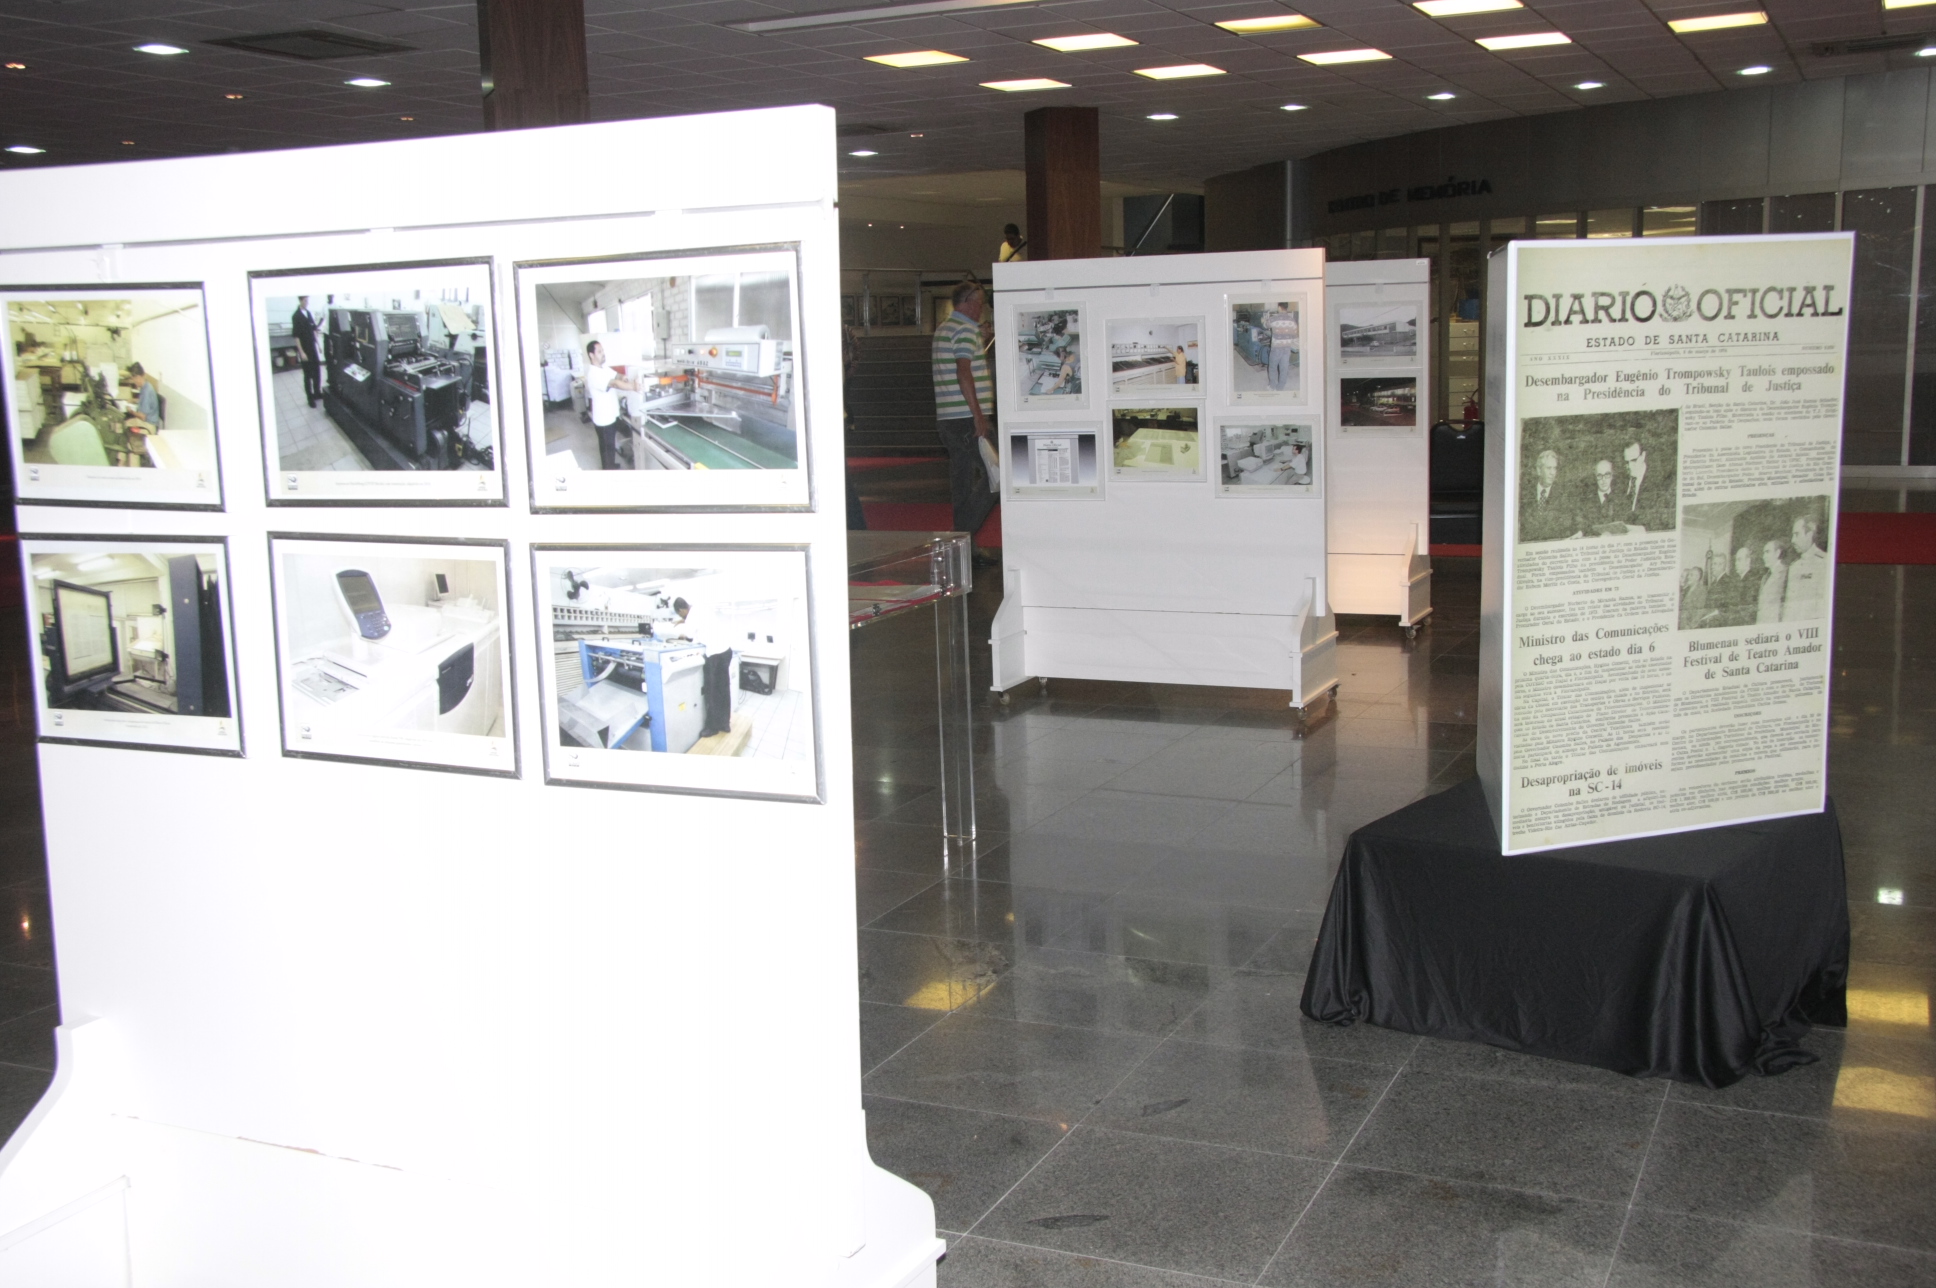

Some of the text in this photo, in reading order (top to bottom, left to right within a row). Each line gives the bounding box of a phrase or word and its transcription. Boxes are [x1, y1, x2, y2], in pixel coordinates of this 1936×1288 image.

[1524, 282, 1843, 328] DIÁRIO OFICIAL
[1586, 332, 1780, 348] ESTADO DE SANTA CATARINA
[1525, 362, 1834, 388] Desembargador Eugênio Trompowsky Taulois empossado
[1556, 378, 1802, 402] na Presidência do Tribunal de Justiça
[1518, 622, 1670, 649] Ministro das Comunicações
[1688, 626, 1820, 652] Blumenau sediará o VIII
[1534, 640, 1656, 666] chega ao estado dia 6
[1683, 642, 1822, 668] Festival de Teatro Amador
[1704, 659, 1800, 680] de Santa Catarina
[1520, 758, 1663, 789] Desapropriação de imóveis
[1568, 786, 1581, 798] na
